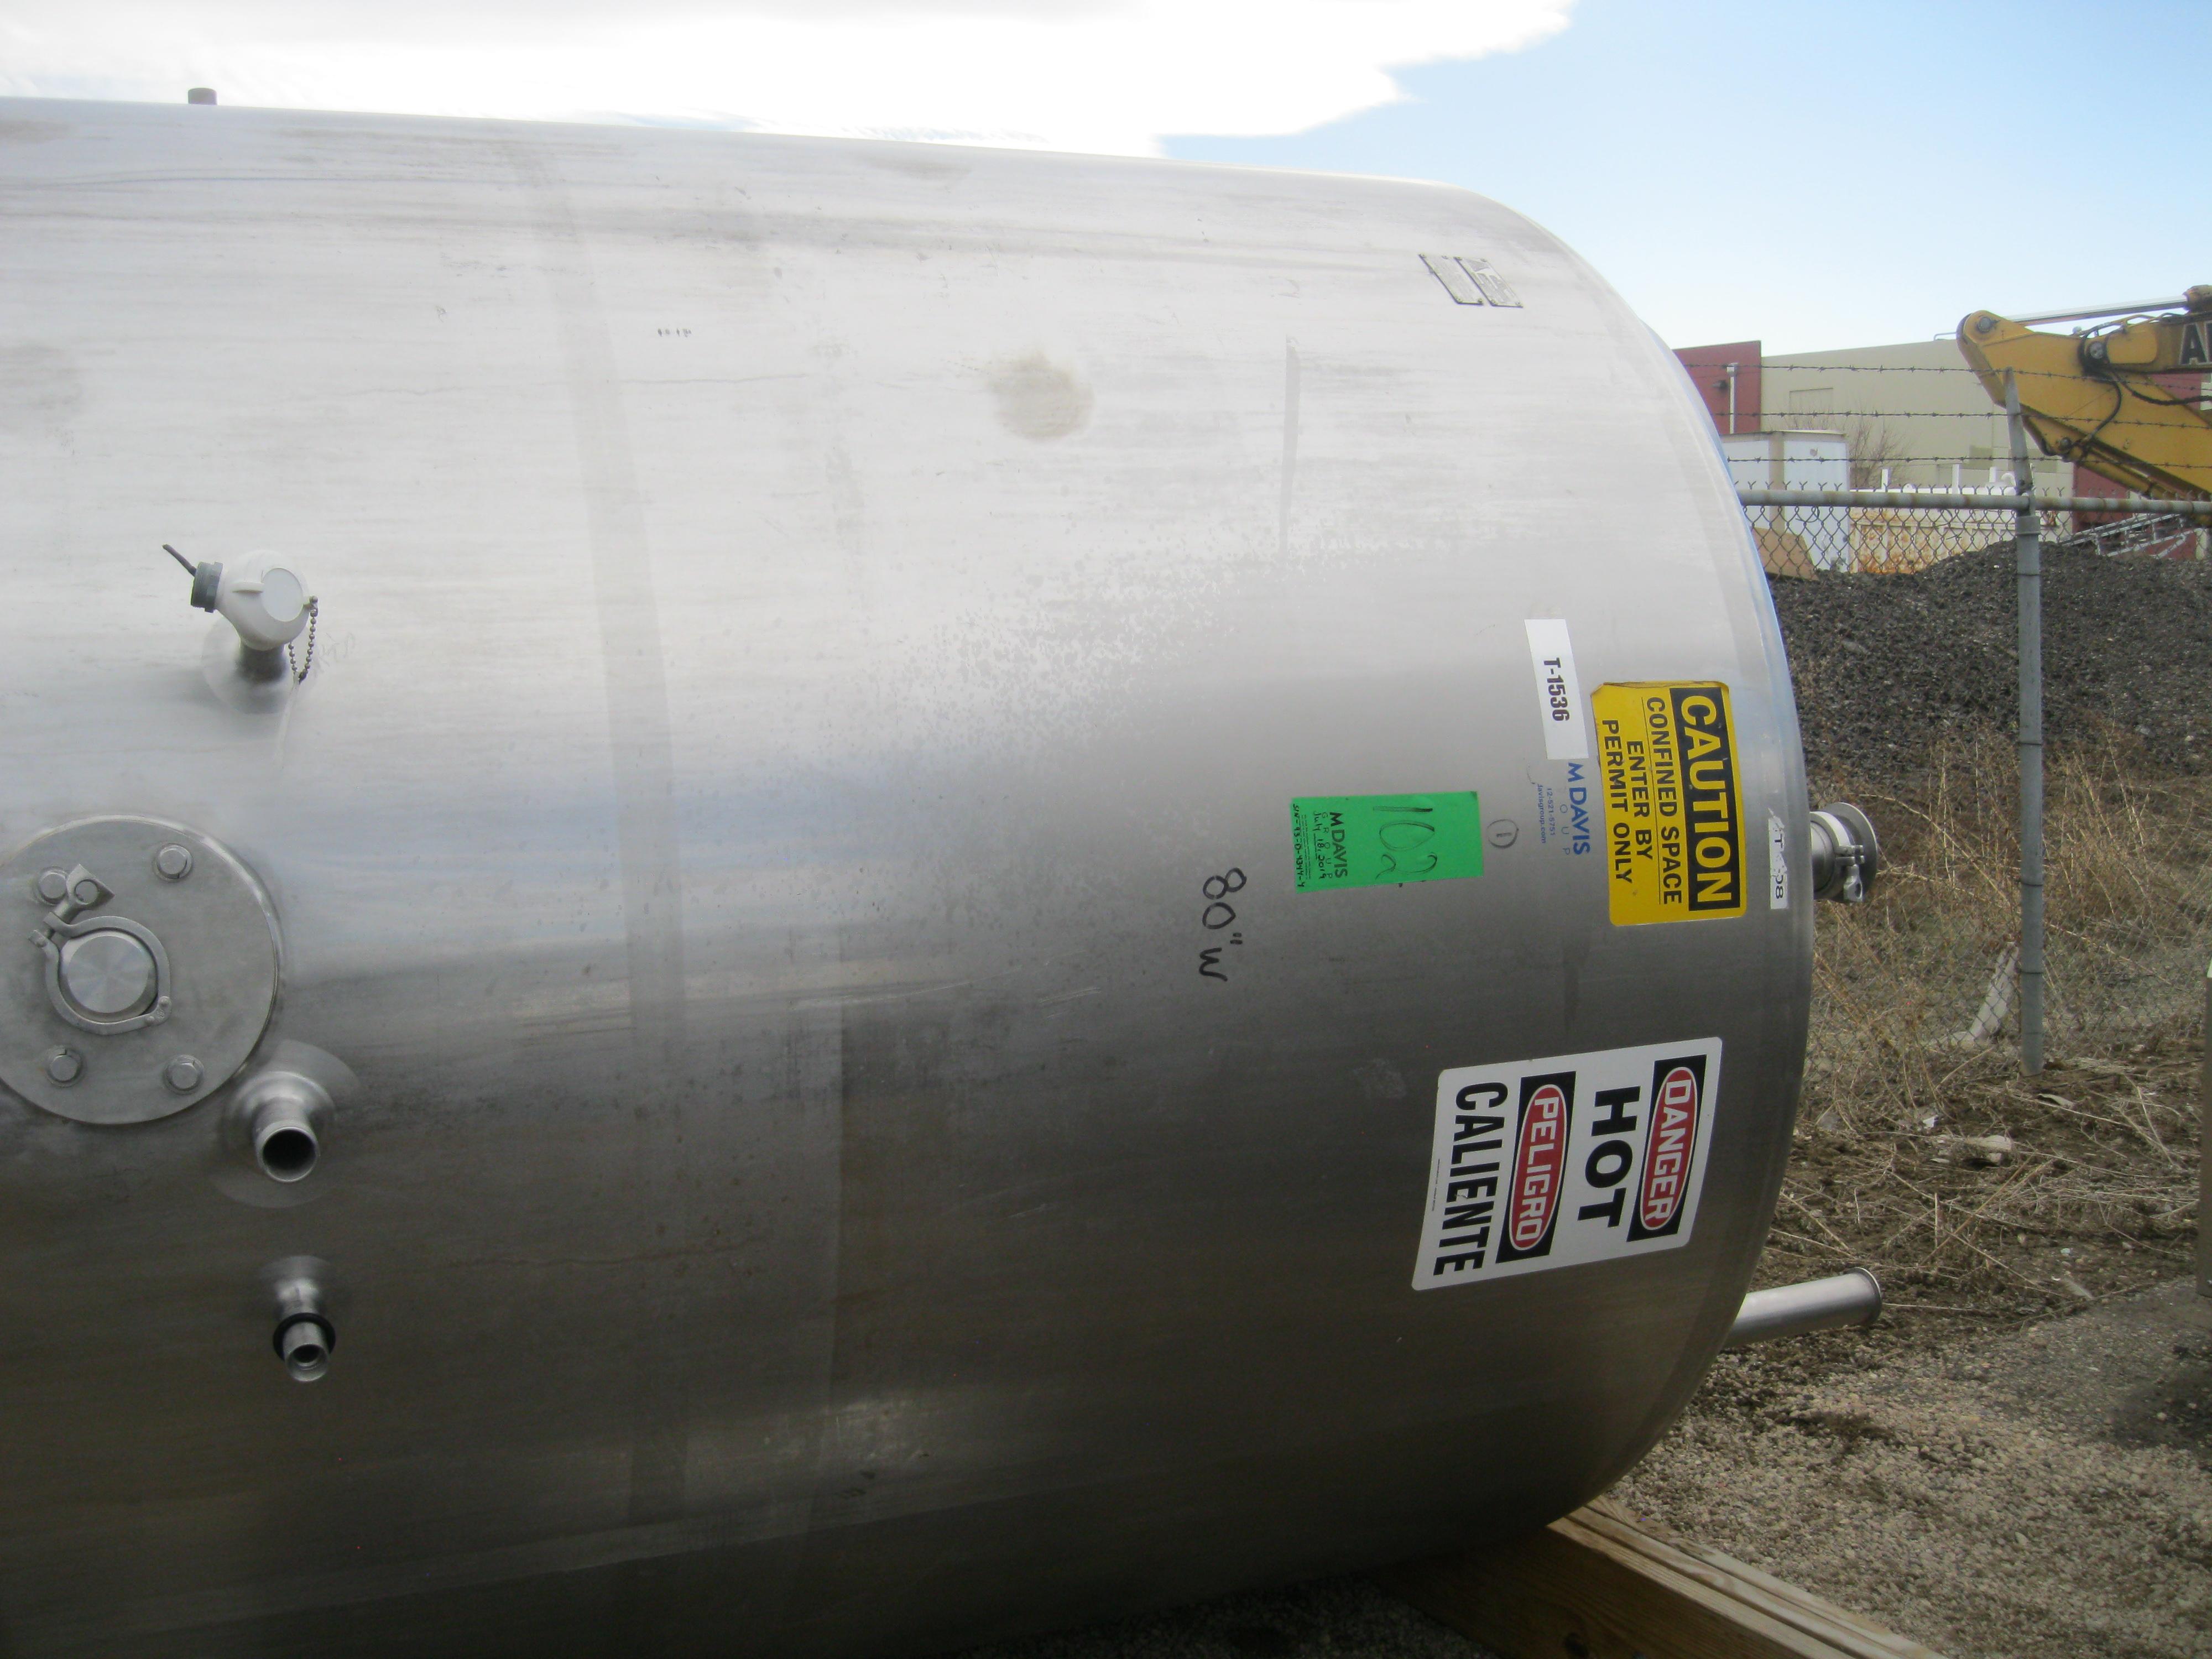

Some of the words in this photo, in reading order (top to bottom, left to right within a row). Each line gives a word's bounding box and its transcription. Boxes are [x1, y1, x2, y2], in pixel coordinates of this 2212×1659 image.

[1542, 656, 1571, 723] T-1536
[1601, 719, 1630, 813] PERMIT
[1626, 740, 1651, 818] ENTER
[1645, 696, 1678, 817] CONFINED
[1681, 695, 1733, 902] CAUTION
[1317, 854, 1326, 879] 2019
[1373, 805, 1437, 880] 102
[1613, 822, 1633, 884] ONLY
[1634, 829, 1653, 860] BY
[1661, 826, 1682, 905] SPACE
[1433, 1082, 1508, 1276] CALIENTE
[1515, 1096, 1560, 1241] PELIGRO
[1577, 1086, 1641, 1229] HOT
[1644, 1079, 1692, 1222] DANGER
